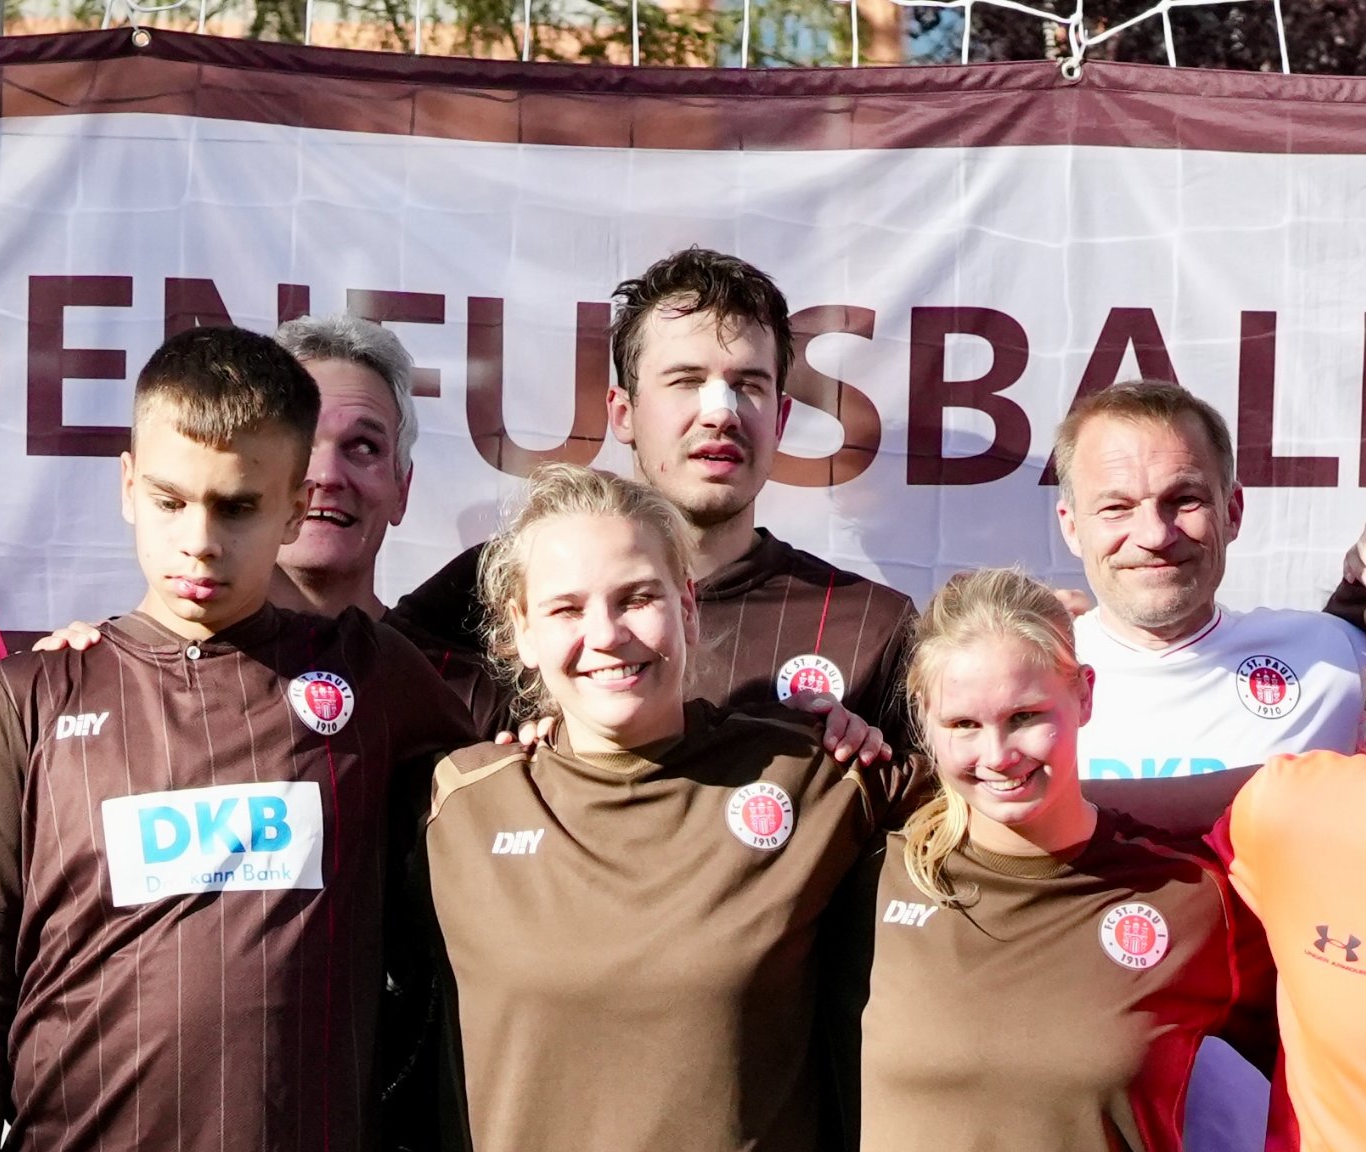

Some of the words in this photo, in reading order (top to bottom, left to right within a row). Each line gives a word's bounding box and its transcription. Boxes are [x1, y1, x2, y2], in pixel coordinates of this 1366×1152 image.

[781, 668, 794, 681] FC
[810, 657, 841, 692] PAULI
[1239, 669, 1249, 683] FC
[1265, 658, 1296, 686] PAULI
[1257, 705, 1282, 716] 1910
[315, 720, 338, 734] 1910
[730, 803, 741, 816] FC
[759, 783, 792, 814] PAULI
[138, 795, 293, 865] DKB
[752, 835, 779, 848] 1910
[190, 867, 235, 885] kann
[244, 863, 292, 883] Bank
[1104, 917, 1116, 930] FC
[1121, 954, 1147, 966] 1910
